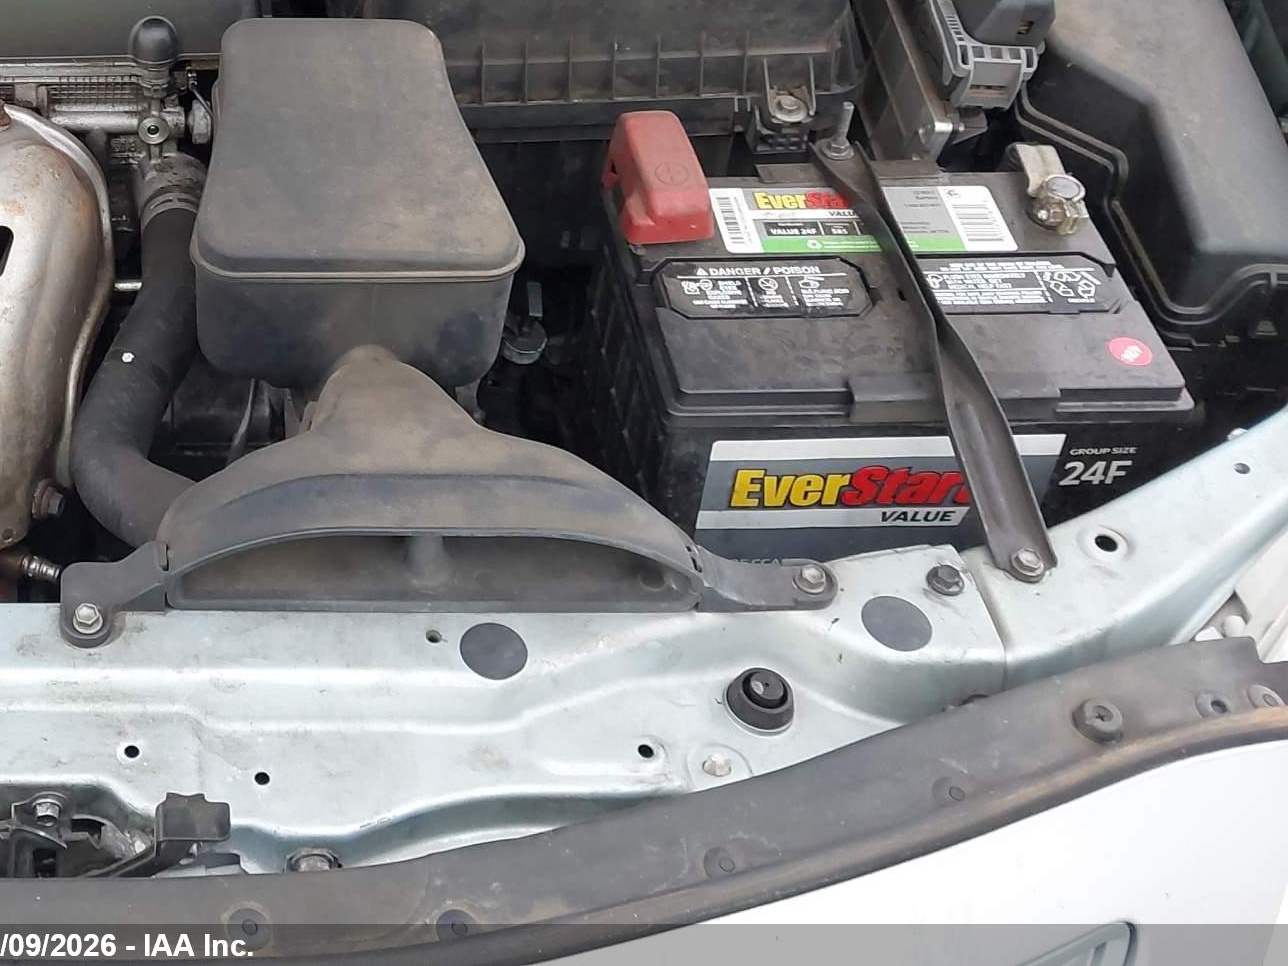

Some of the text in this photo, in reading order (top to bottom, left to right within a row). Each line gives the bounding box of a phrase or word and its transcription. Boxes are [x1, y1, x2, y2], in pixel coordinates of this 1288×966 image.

[708, 266, 761, 276] DANGER
[773, 265, 822, 275] POISON
[1069, 446, 1138, 456] GROUP SIZE
[1058, 460, 1133, 486] 24F
[880, 510, 956, 523] VALUE
